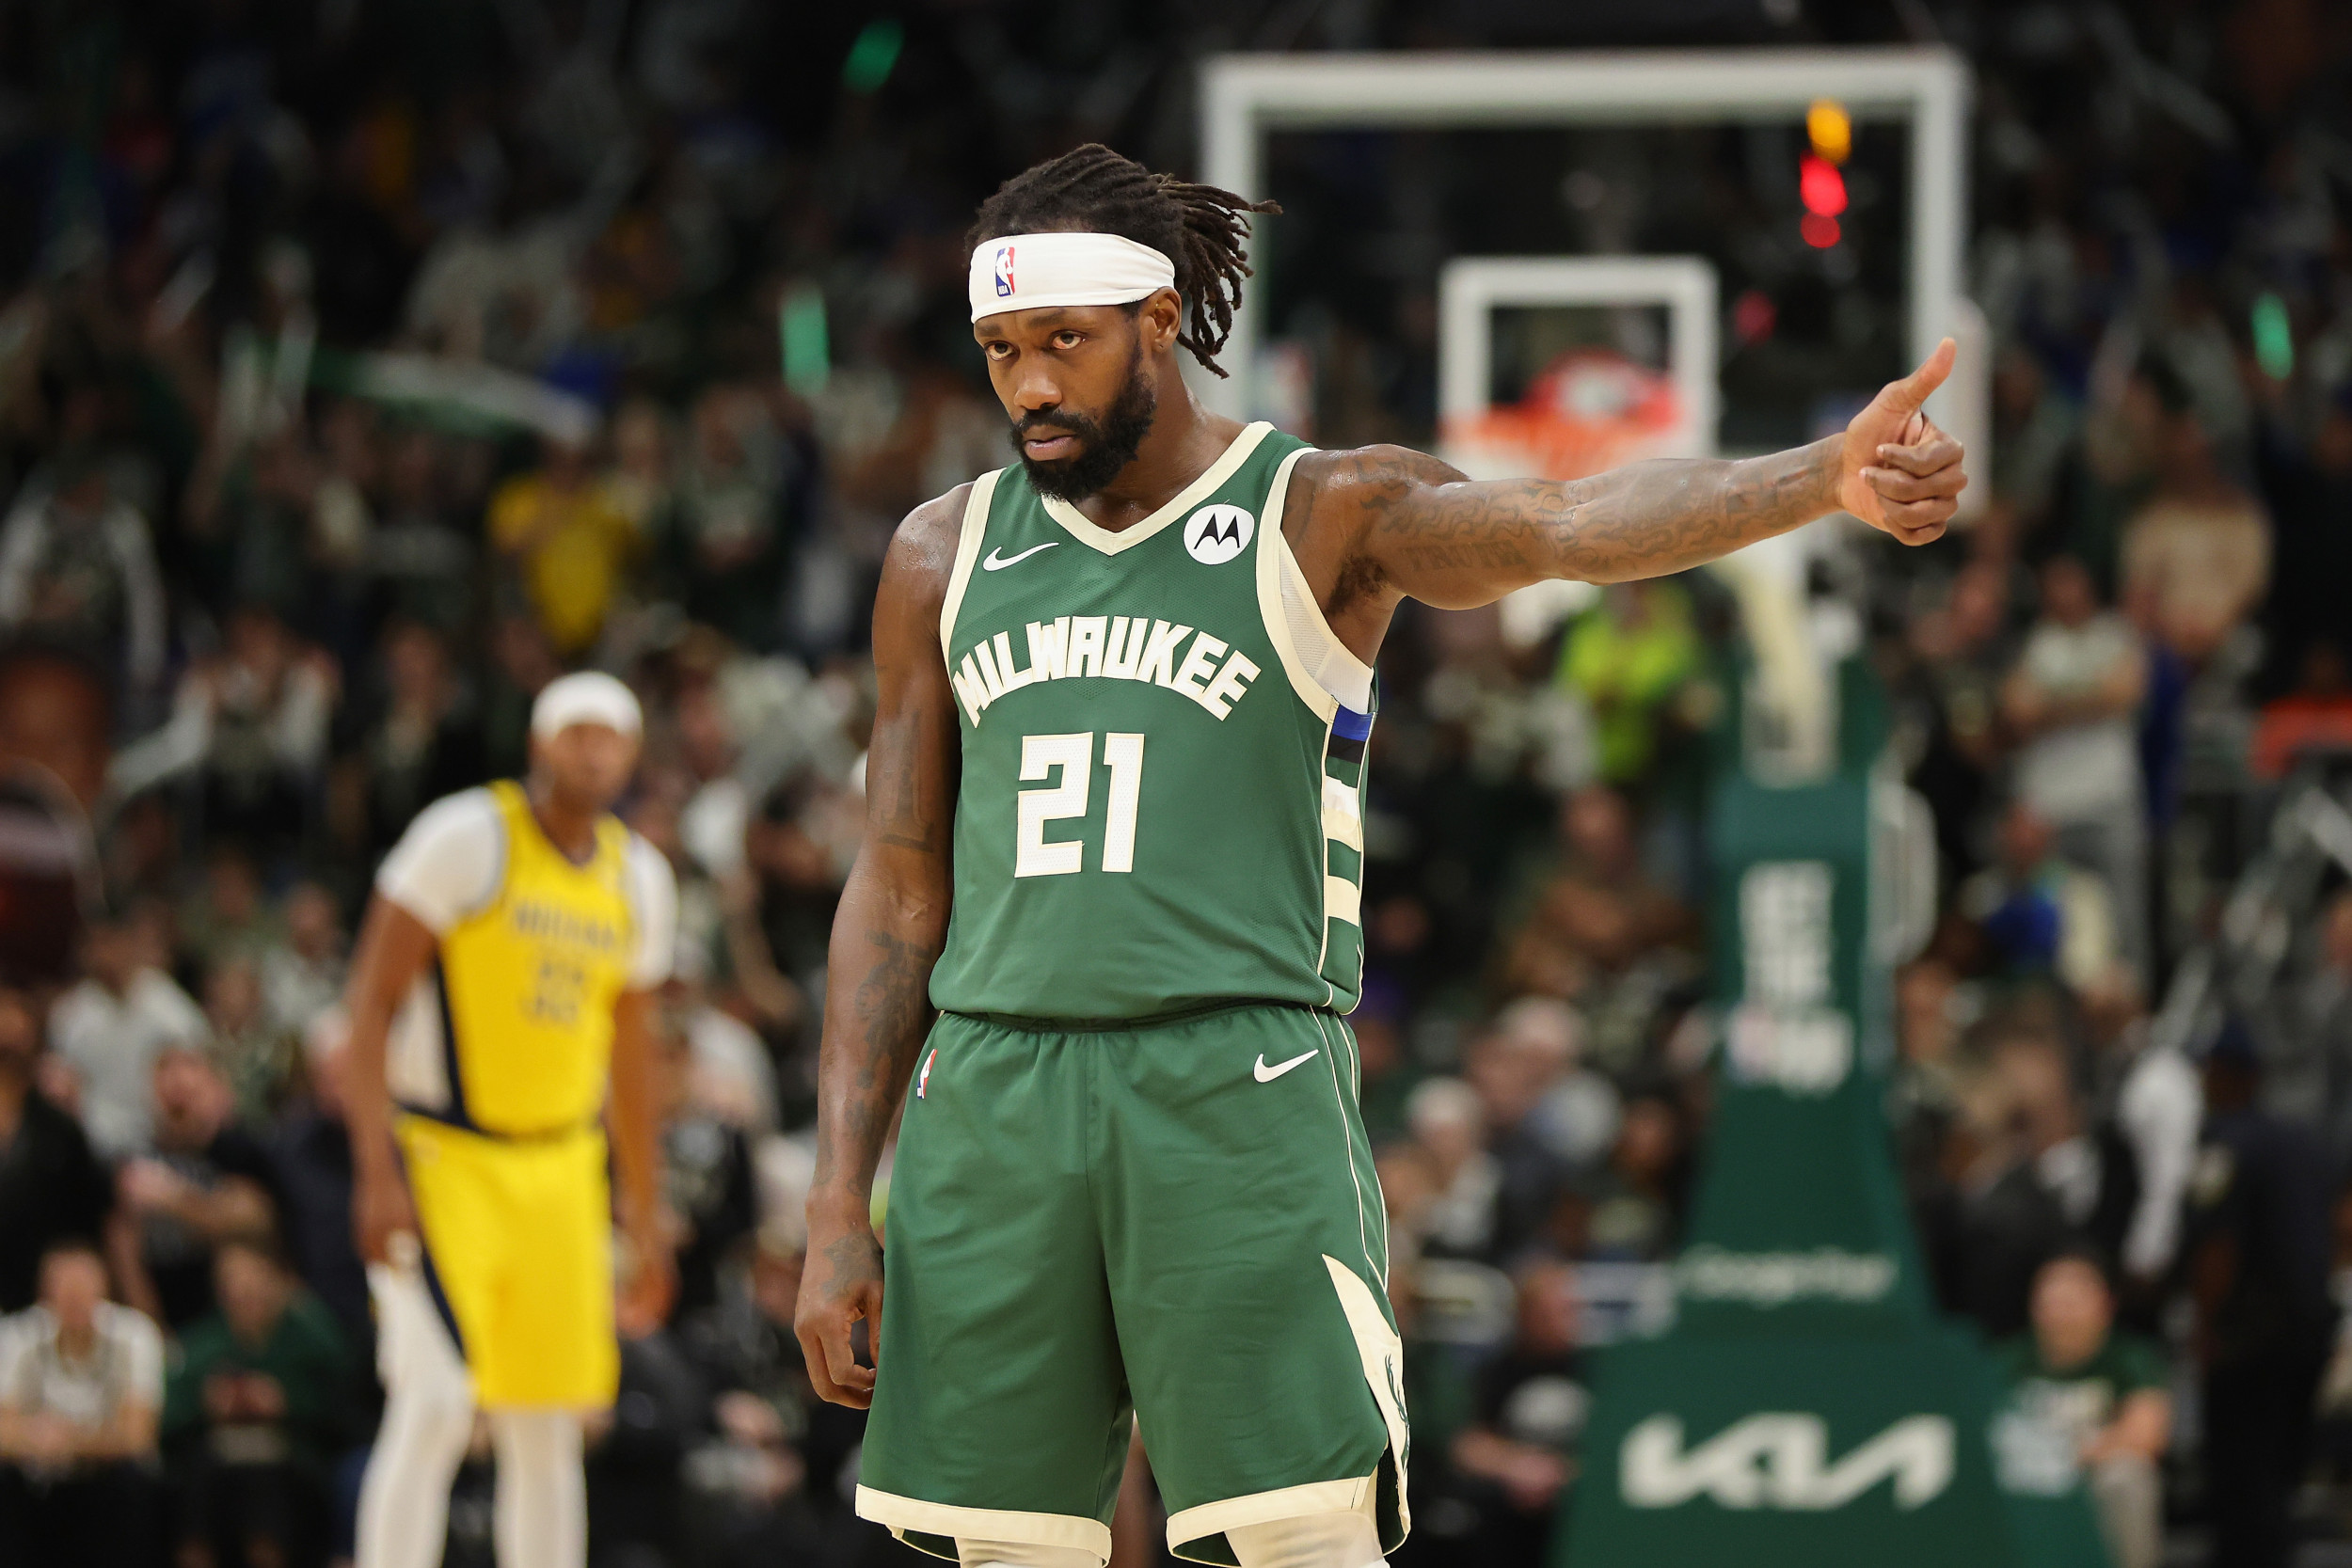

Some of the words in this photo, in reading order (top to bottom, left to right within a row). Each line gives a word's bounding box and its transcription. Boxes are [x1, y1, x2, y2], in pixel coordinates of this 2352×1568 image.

[952, 615, 1262, 728] MILWAUKEE
[1014, 731, 1145, 879] 21
[1619, 1413, 1957, 1510] KIA
